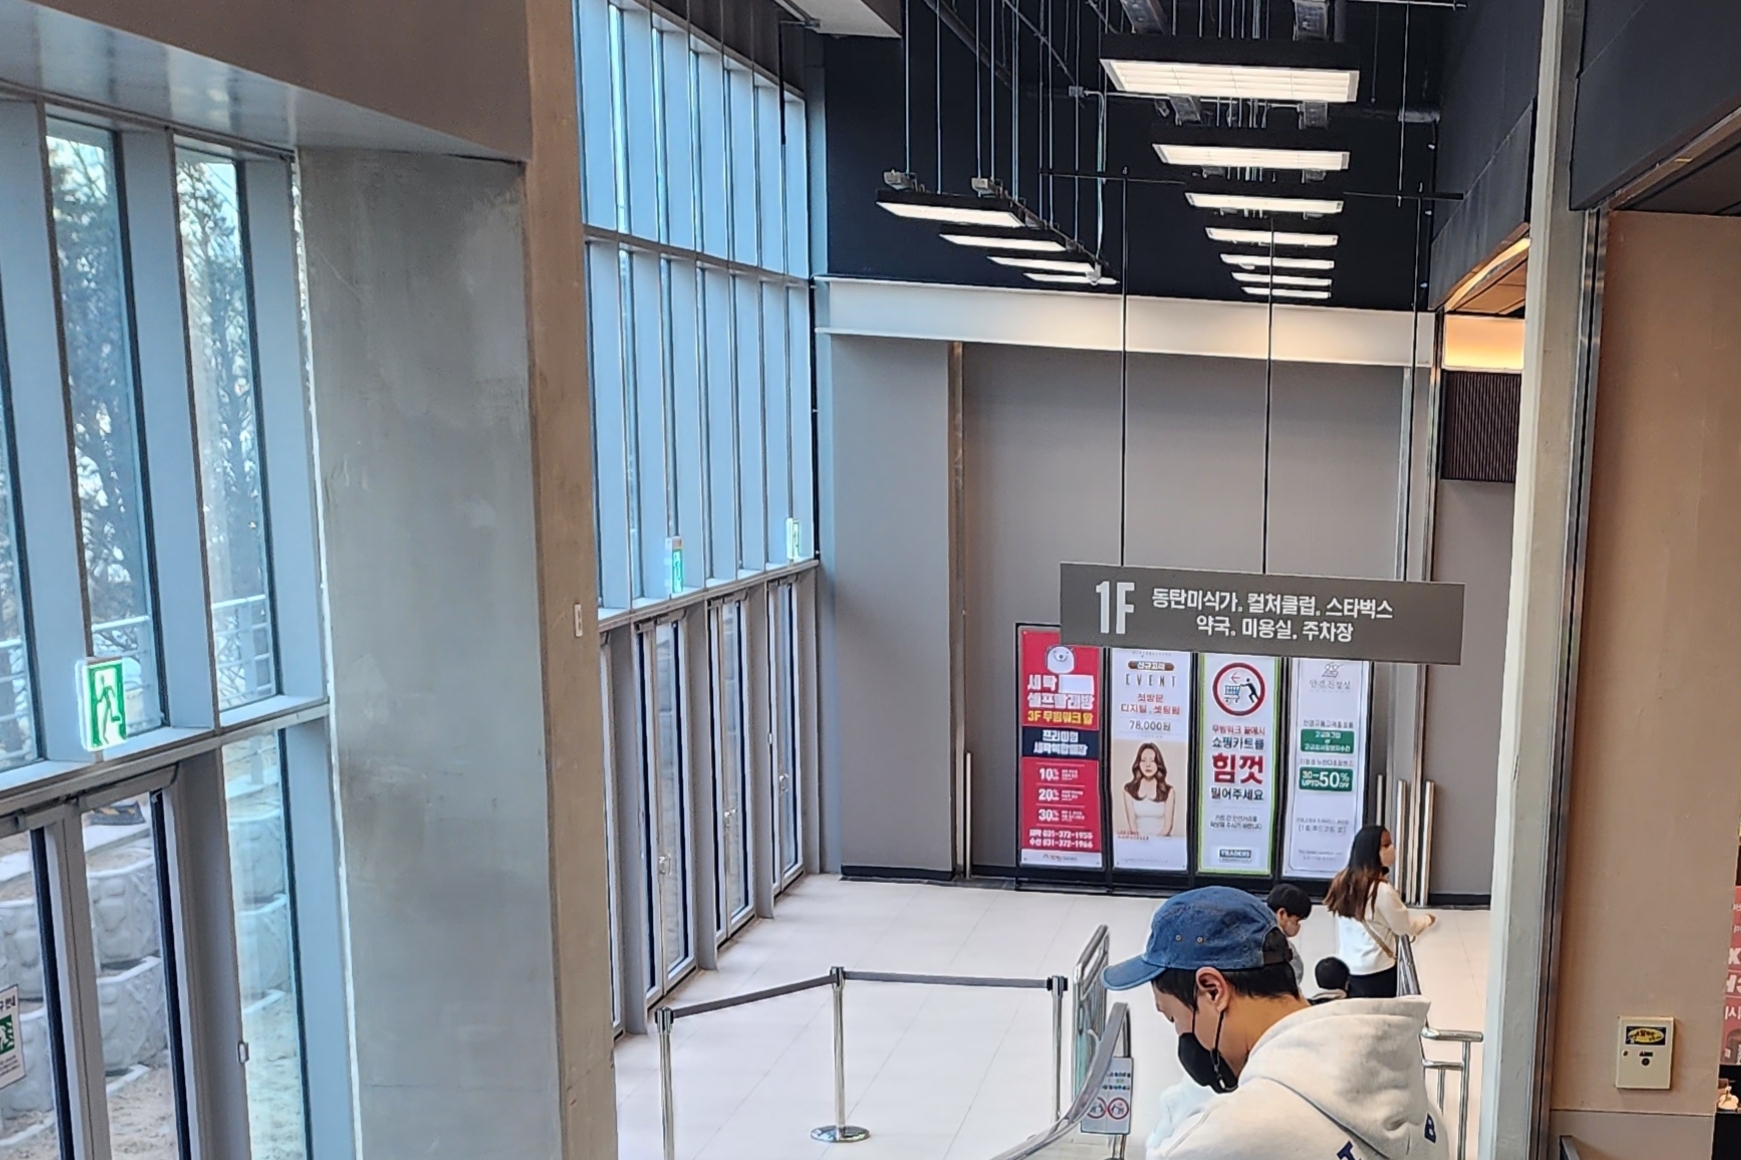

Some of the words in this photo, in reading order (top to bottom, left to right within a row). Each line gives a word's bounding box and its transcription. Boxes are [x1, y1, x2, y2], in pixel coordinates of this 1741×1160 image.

[1096, 581, 1135, 635] 1F
[1325, 597, 1393, 619] 스타벅스
[1302, 621, 1354, 642] 주차장
[1125, 674, 1176, 687] EVENT
[1027, 710, 1042, 722] 3F
[1129, 720, 1171, 731] 78,000원
[1212, 737, 1264, 750] 쇼핑카트를
[1212, 753, 1263, 785] 힘껏
[1211, 787, 1264, 800] 밀어주세요
